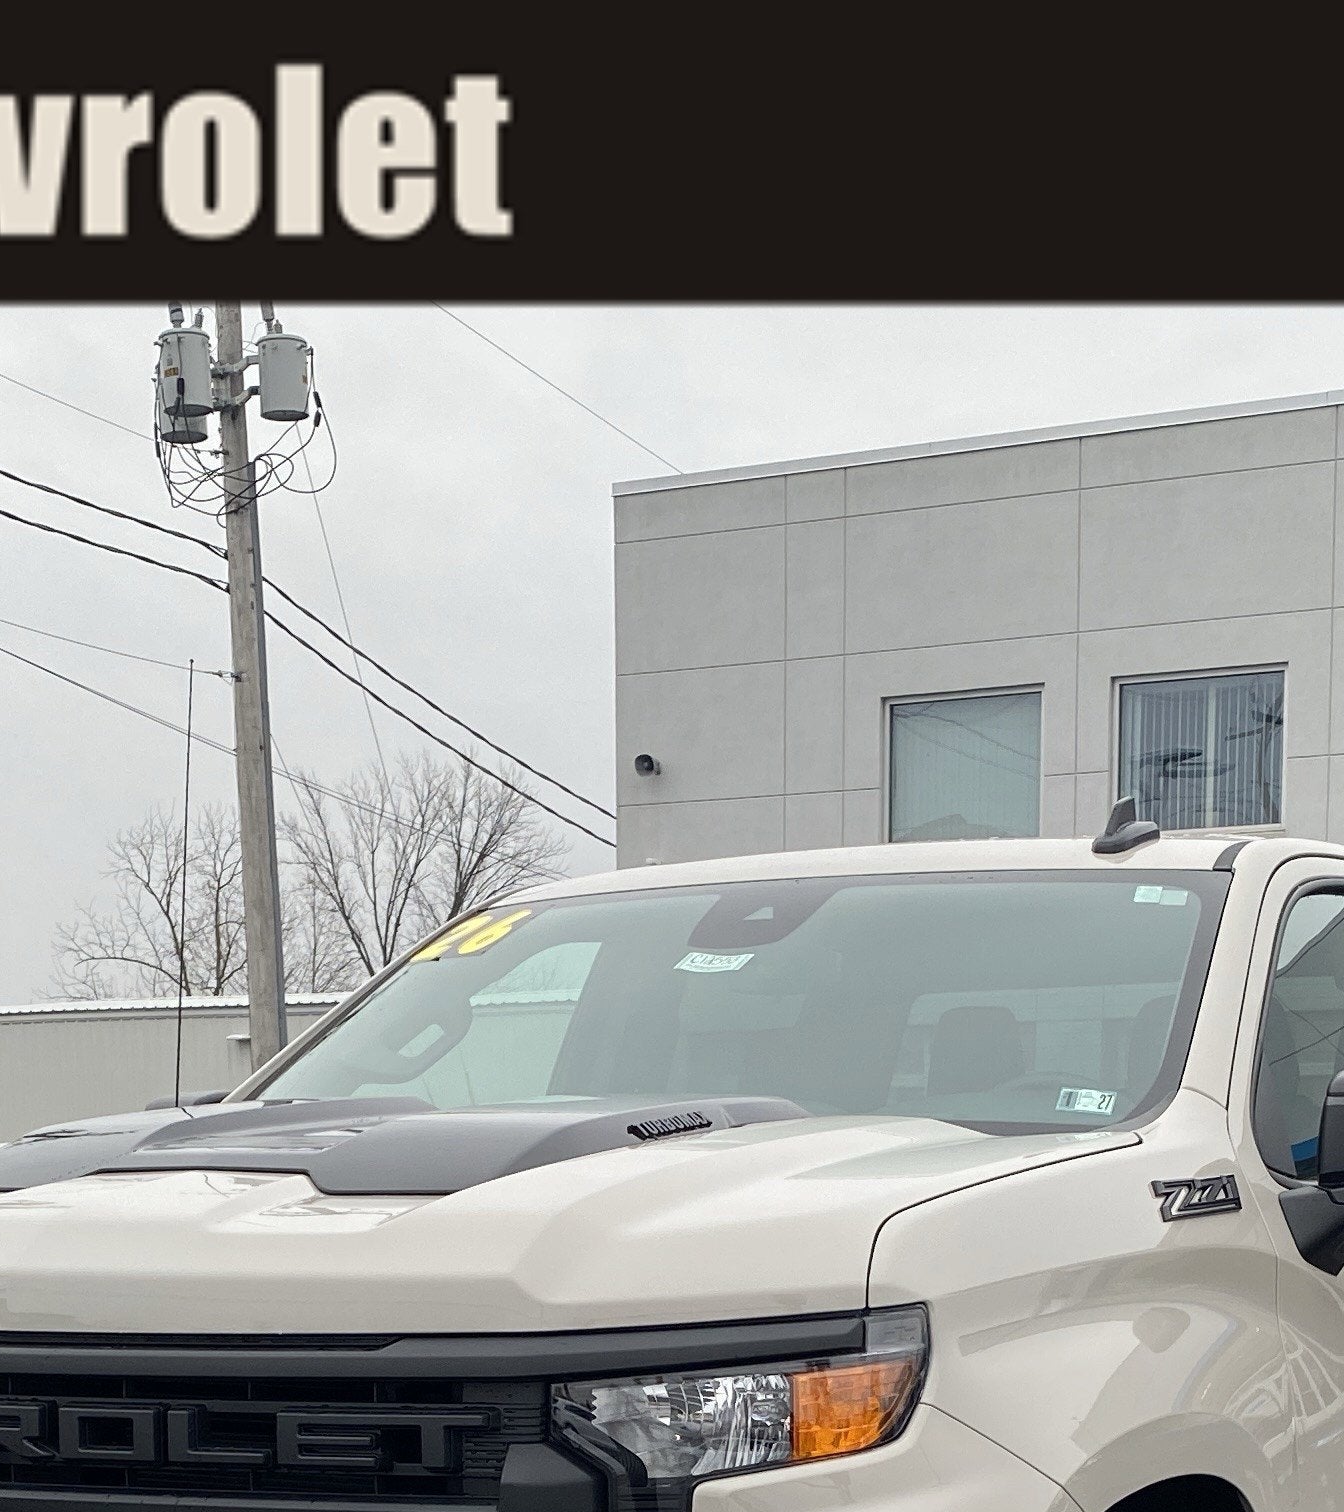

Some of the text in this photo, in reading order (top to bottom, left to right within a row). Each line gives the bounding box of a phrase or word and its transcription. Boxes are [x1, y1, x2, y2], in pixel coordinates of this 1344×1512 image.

[410, 907, 533, 963] 26
[1097, 1094, 1113, 1110] 27
[1149, 1174, 1243, 1223] Z71
